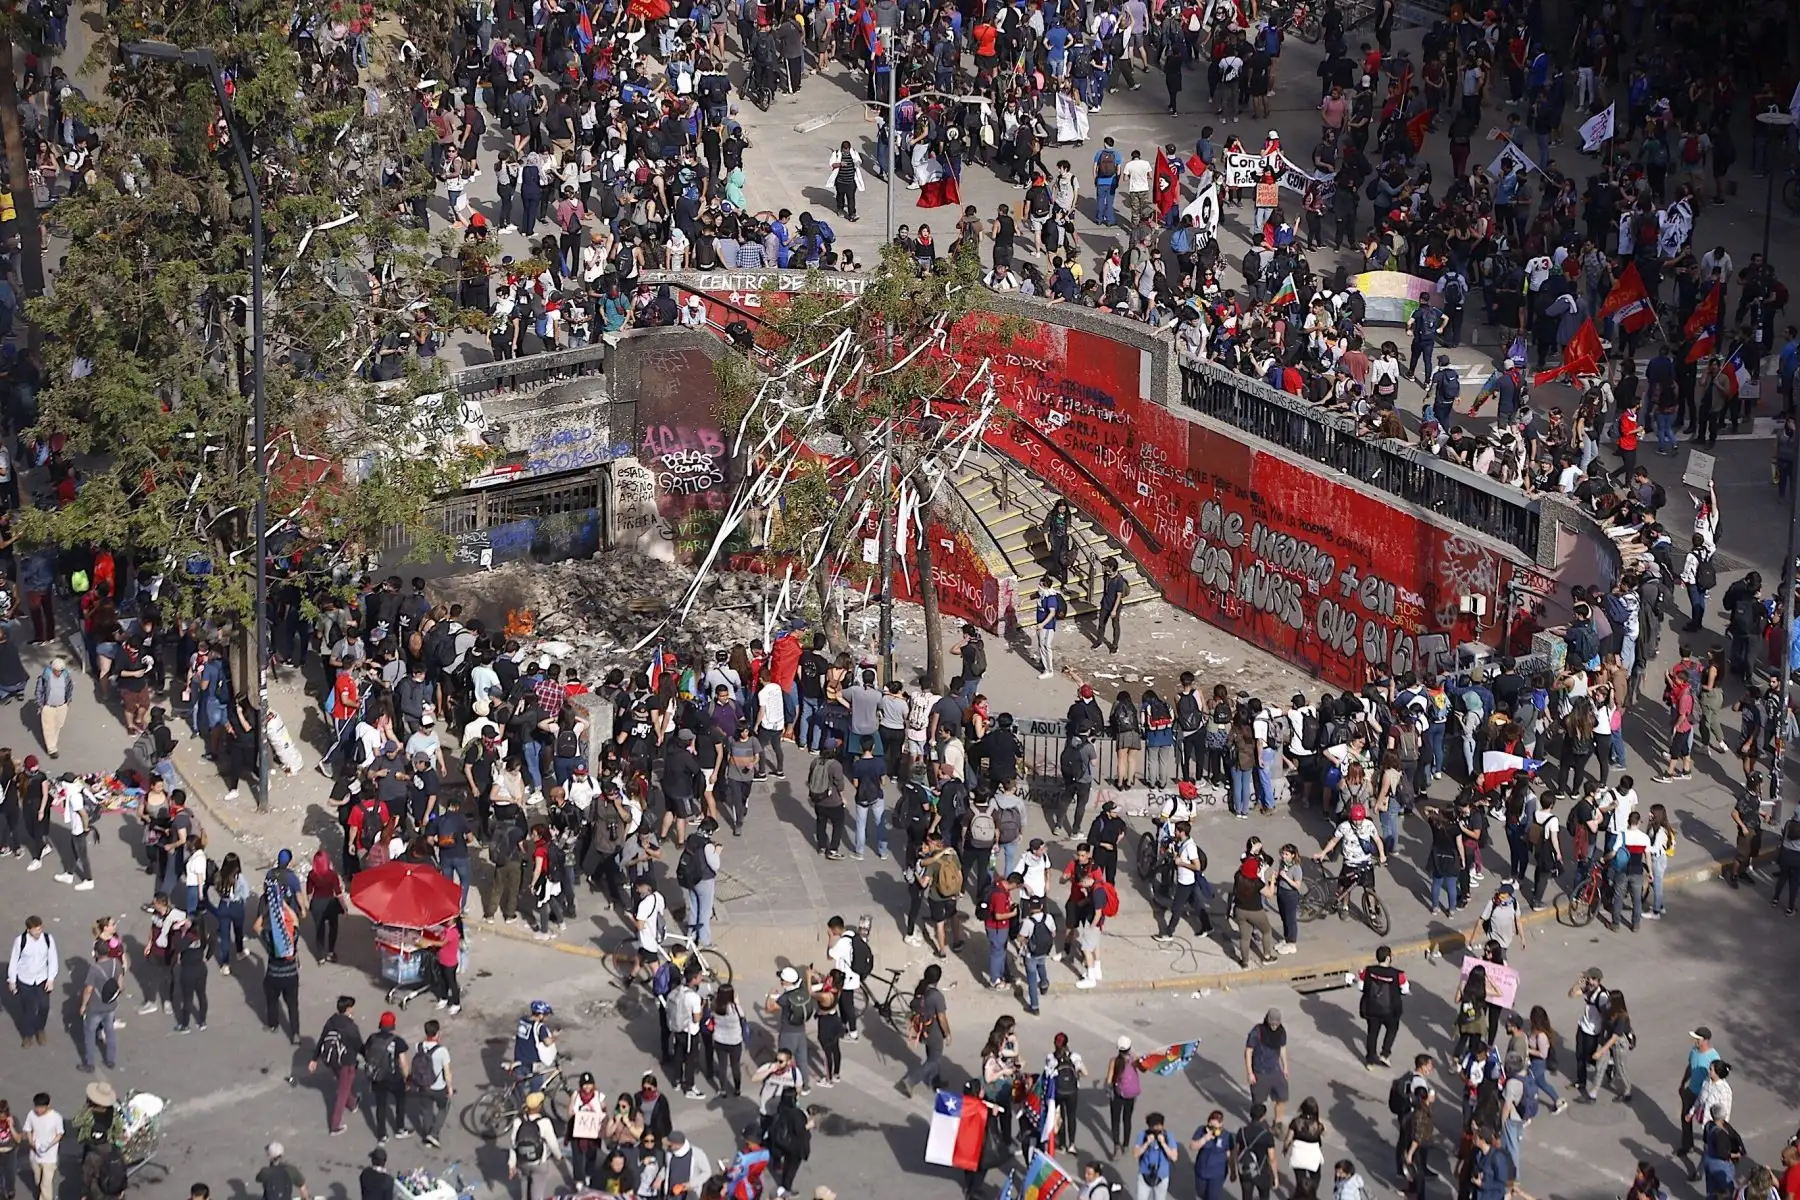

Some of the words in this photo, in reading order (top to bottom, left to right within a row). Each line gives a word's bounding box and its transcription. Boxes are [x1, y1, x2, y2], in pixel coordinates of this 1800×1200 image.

[1228, 153, 1256, 168] Con
[699, 273, 764, 291] CENTRO
[779, 274, 806, 290] DE
[661, 448, 713, 470] BALAS
[626, 502, 637, 513] A
[1250, 521, 1336, 586] INFORMO
[1190, 537, 1234, 594] LOS
[1235, 562, 1304, 630] MUROS
